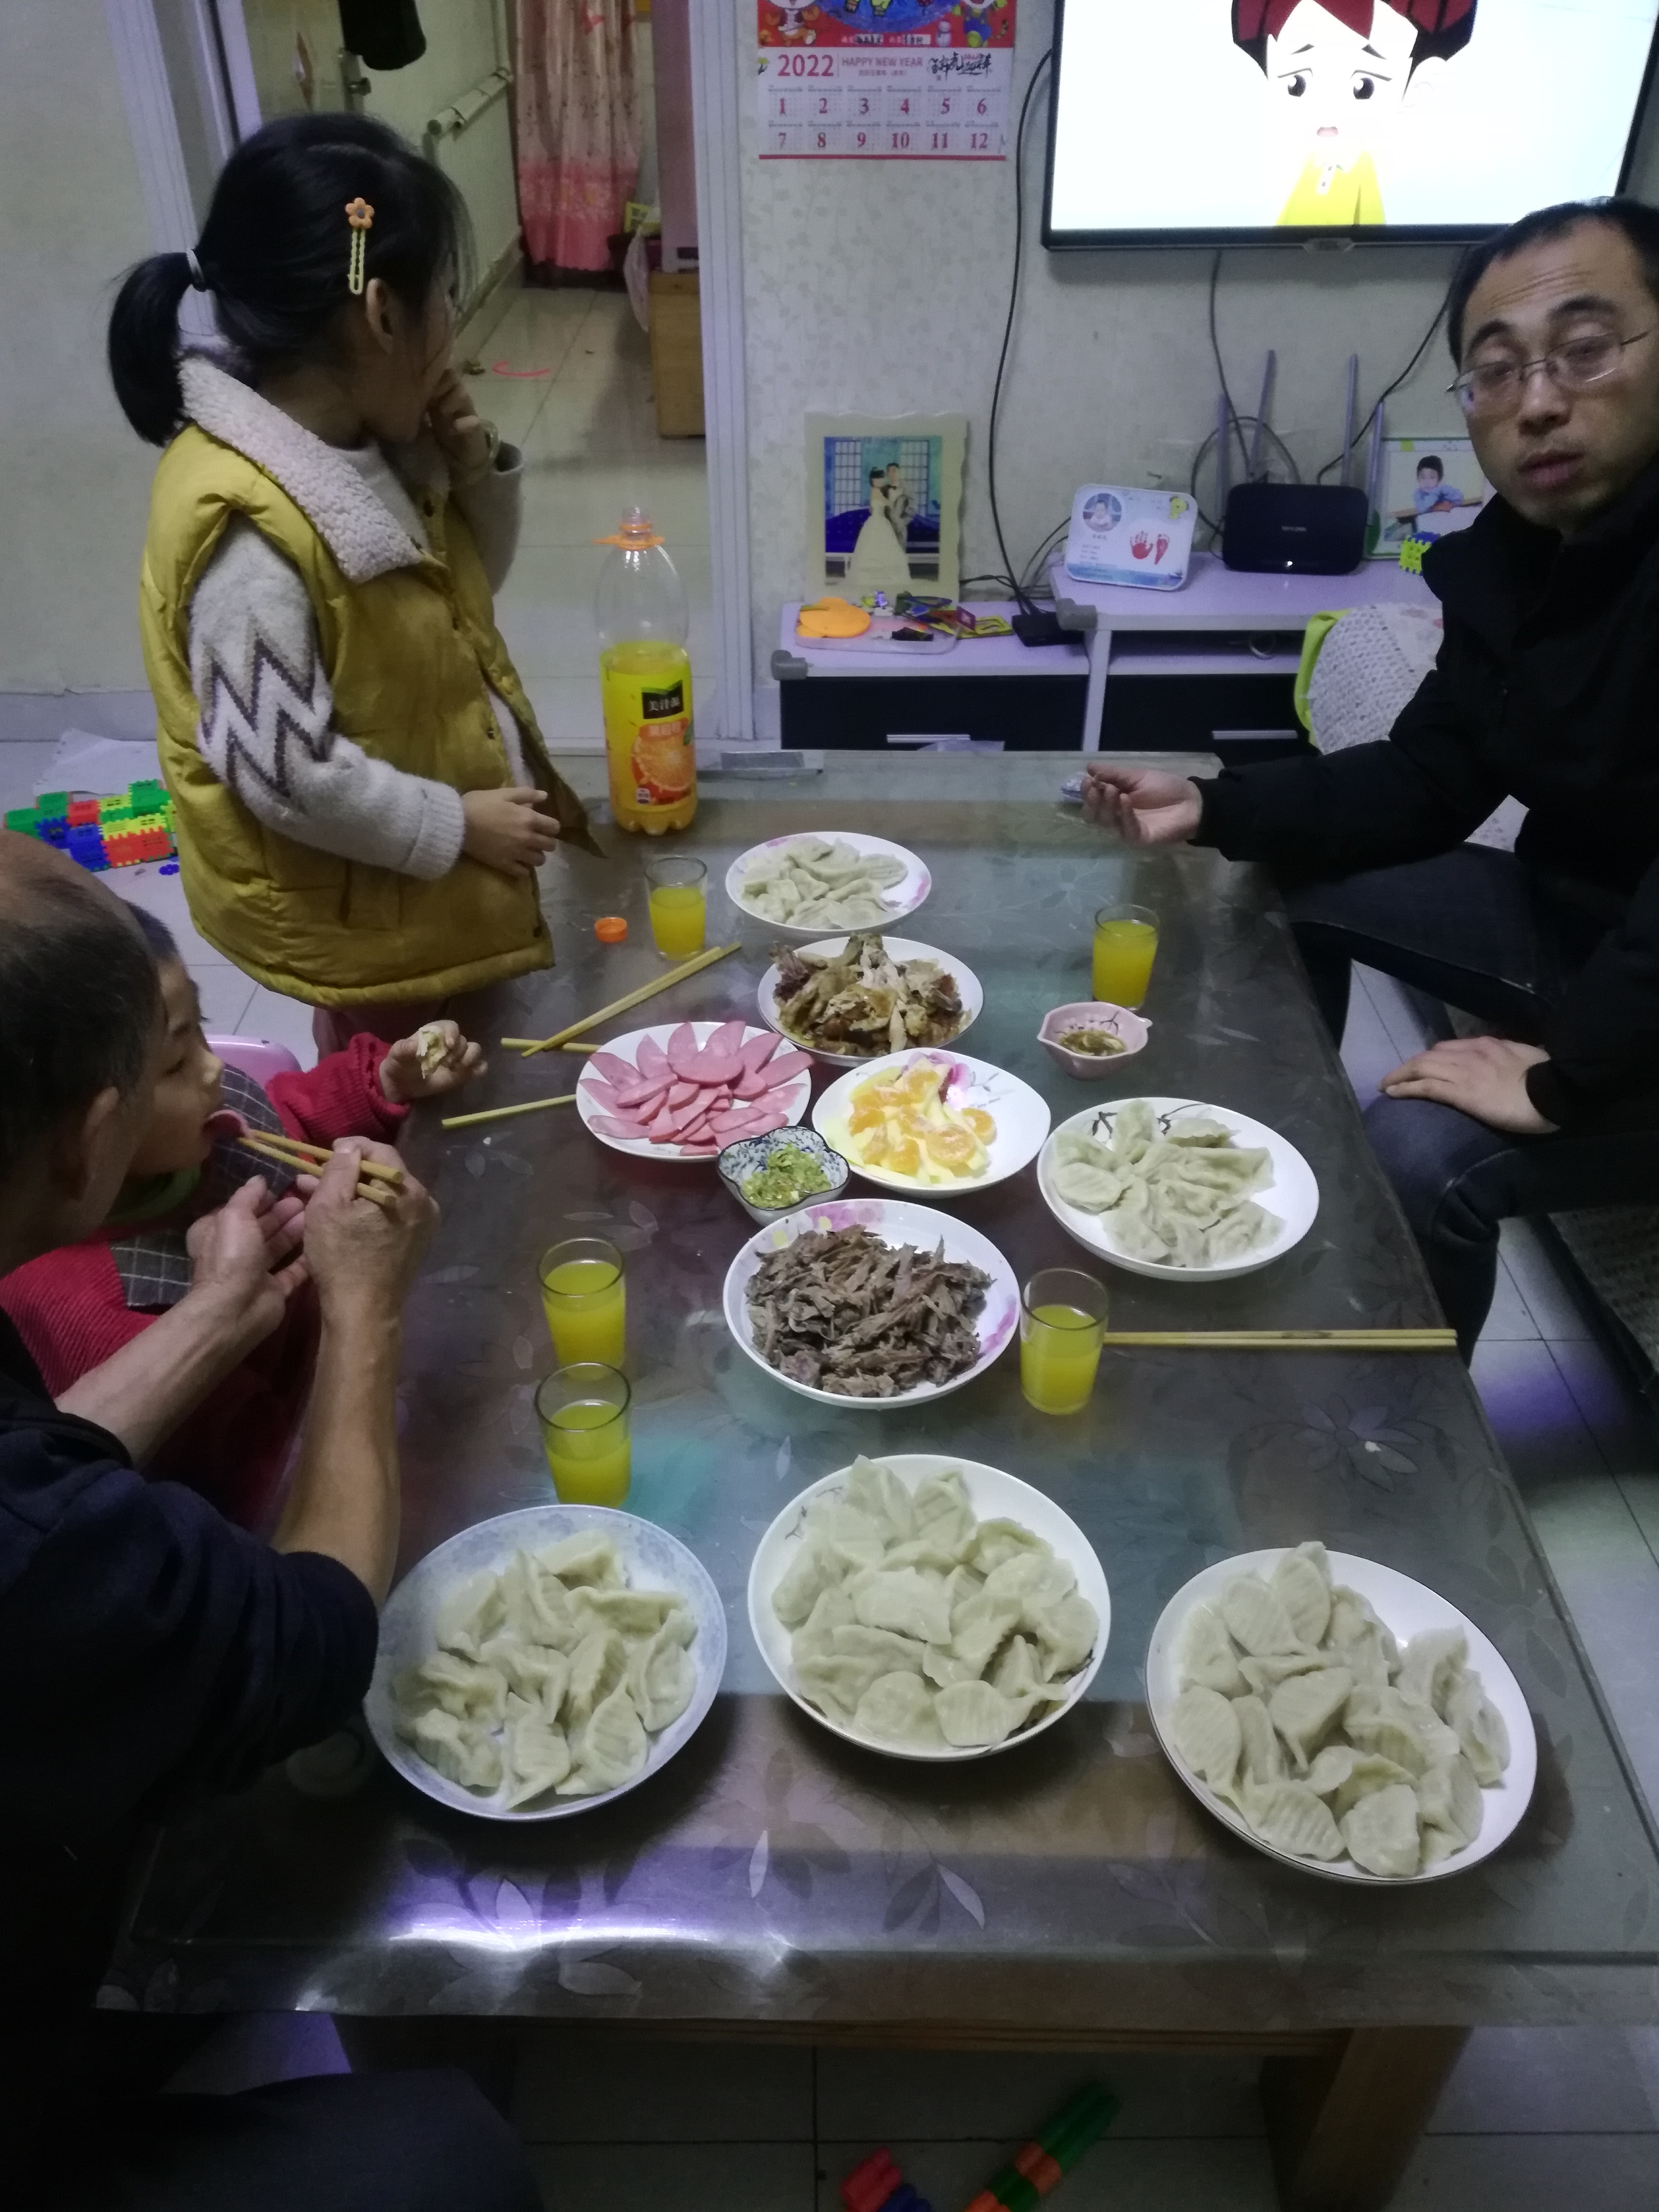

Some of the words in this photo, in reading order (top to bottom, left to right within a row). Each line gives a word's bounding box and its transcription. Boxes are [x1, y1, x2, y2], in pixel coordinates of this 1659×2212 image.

[777, 54, 834, 77] 2022
[842, 56, 873, 66] HAPPY
[876, 57, 896, 67] NEW
[899, 57, 923, 67] YEAR
[779, 98, 785, 114] 1
[819, 98, 828, 114] 2
[860, 98, 869, 115] 3
[900, 98, 909, 113] 4
[940, 98, 950, 114] 5
[977, 98, 986, 115] 6
[778, 132, 787, 147] 7
[817, 132, 826, 147] 8
[857, 132, 866, 147] 9
[891, 132, 910, 147] 10
[932, 132, 948, 148] 11
[970, 132, 988, 148] 12
